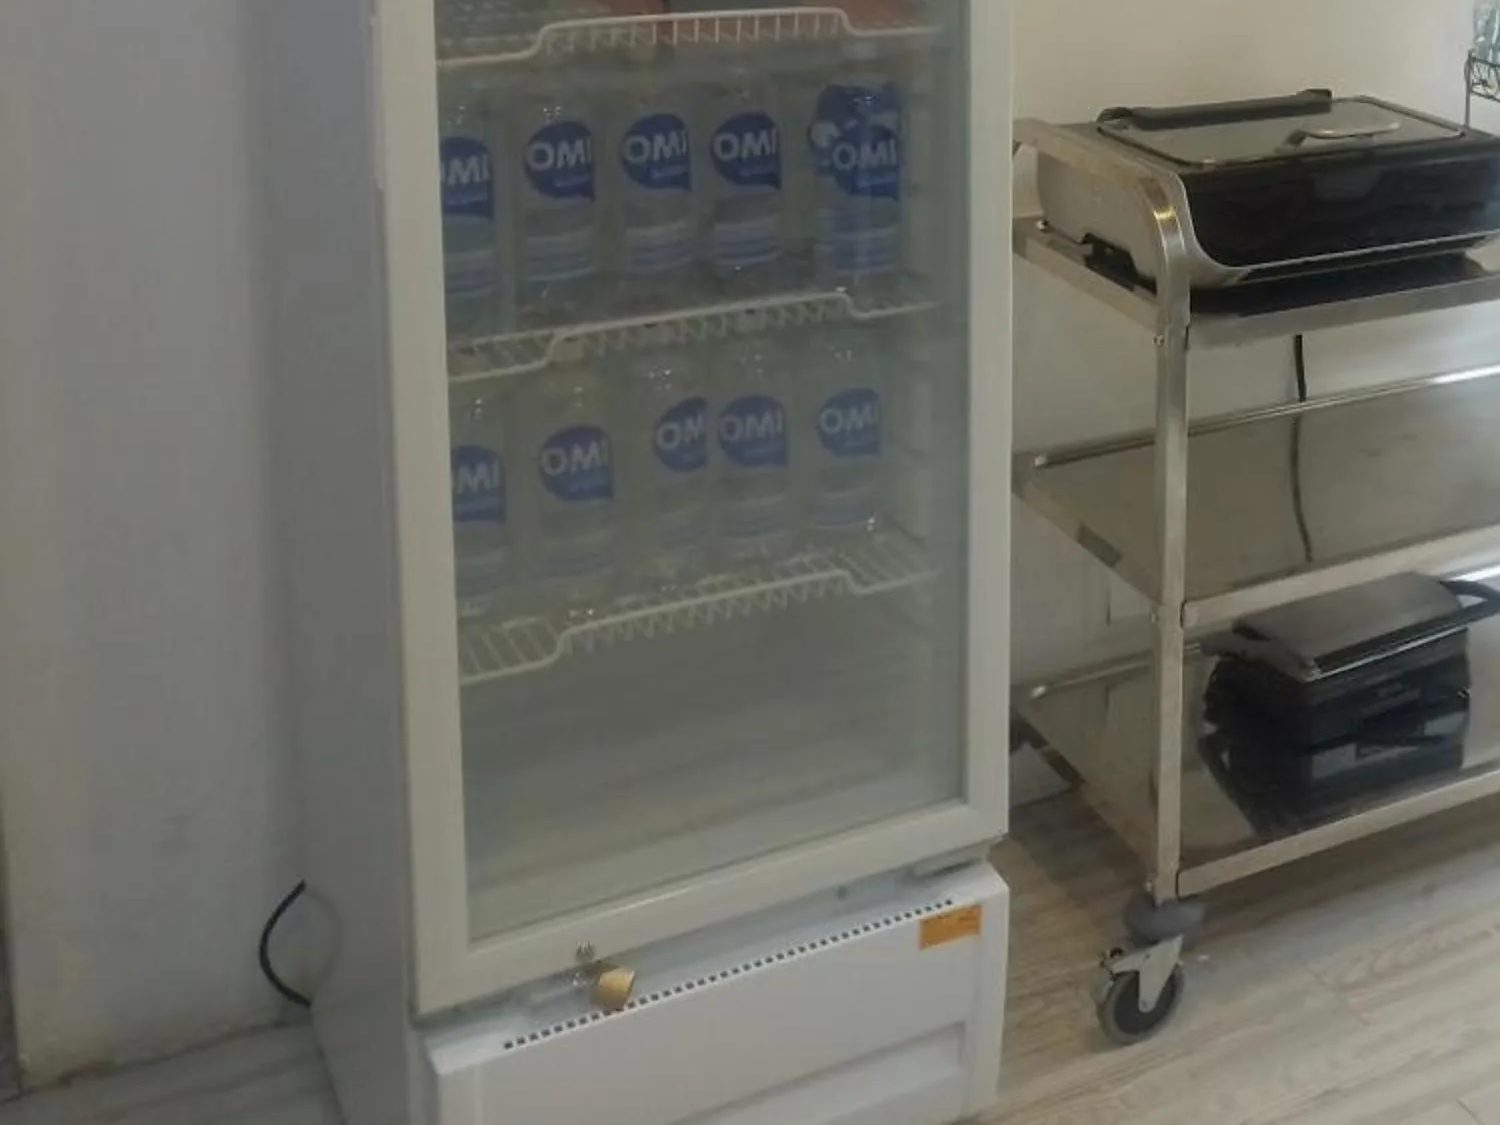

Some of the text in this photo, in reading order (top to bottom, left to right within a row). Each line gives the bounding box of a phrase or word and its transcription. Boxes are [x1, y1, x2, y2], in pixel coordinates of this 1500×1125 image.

[526, 137, 592, 172] OMI
[623, 129, 688, 164] OMI
[713, 127, 778, 162] OMI
[440, 152, 490, 186] MI
[656, 412, 704, 452] OM
[453, 458, 499, 494] MI
